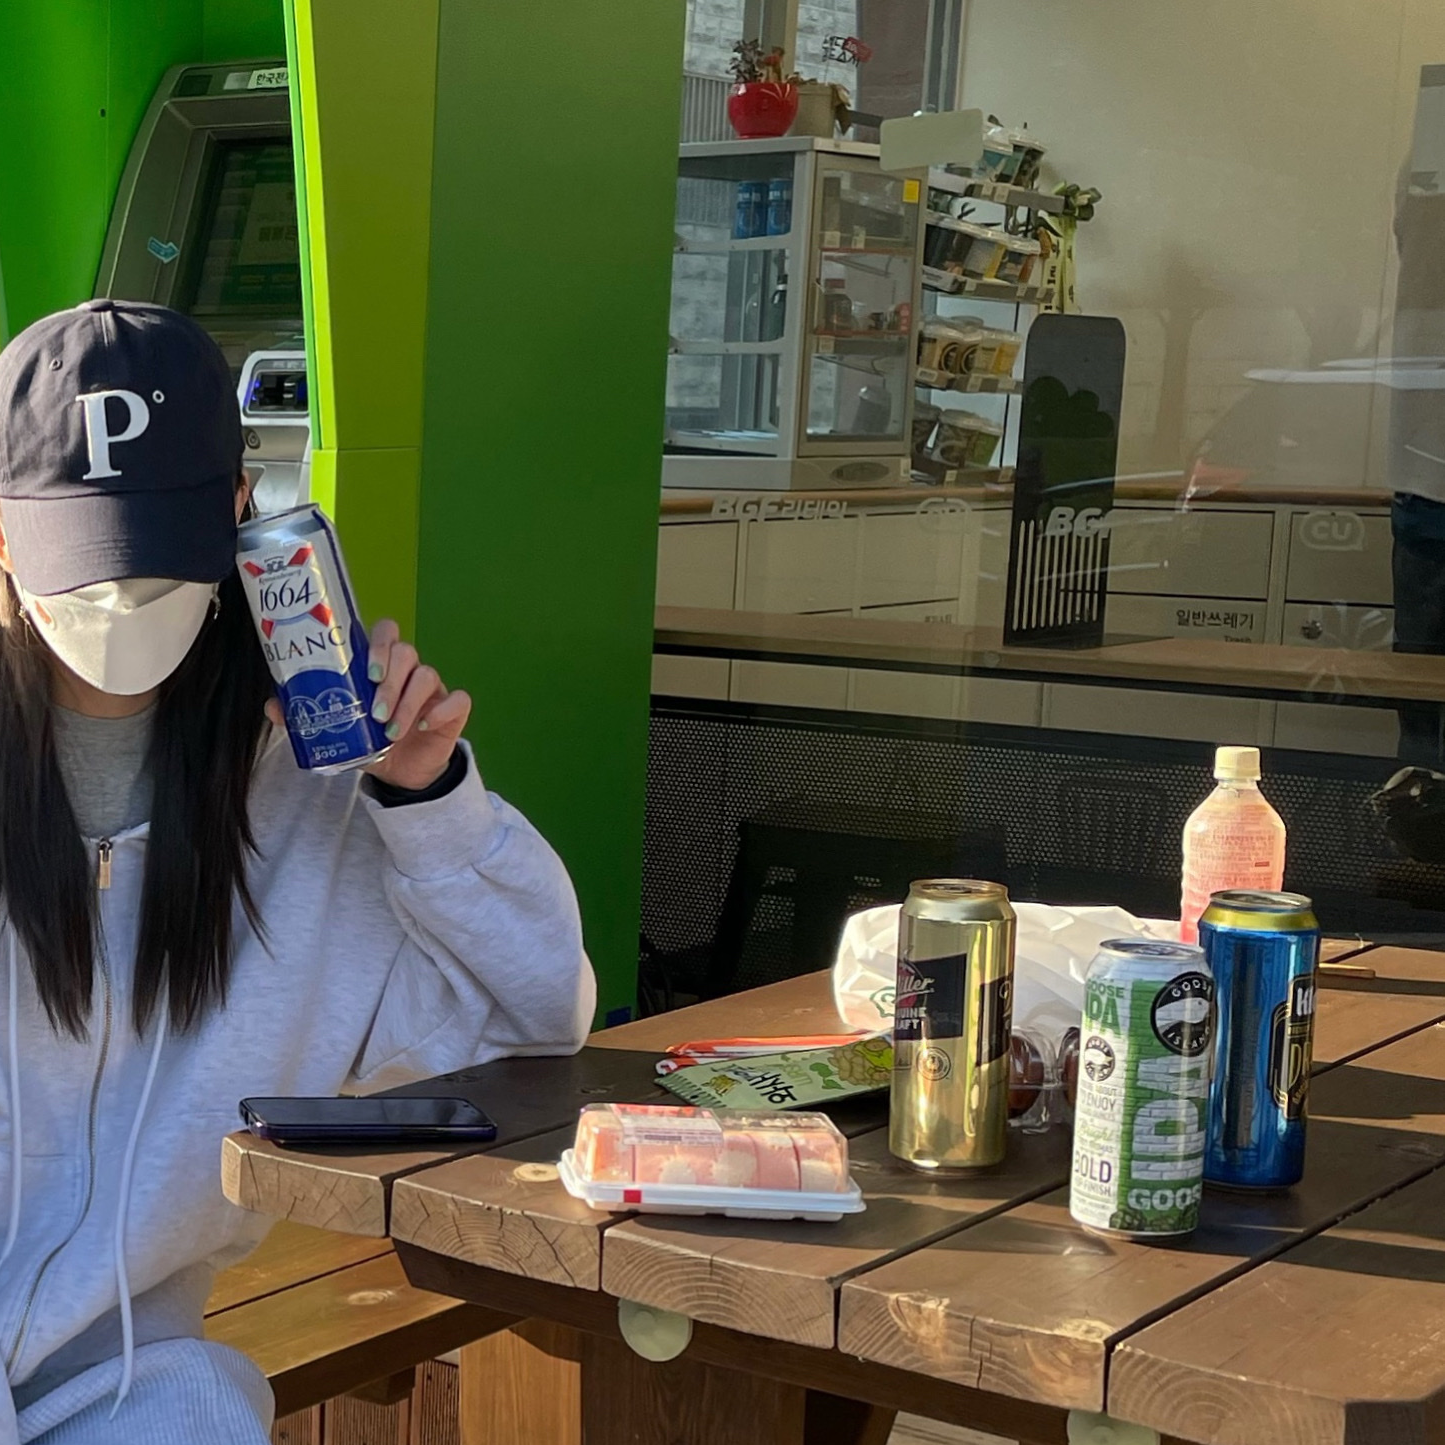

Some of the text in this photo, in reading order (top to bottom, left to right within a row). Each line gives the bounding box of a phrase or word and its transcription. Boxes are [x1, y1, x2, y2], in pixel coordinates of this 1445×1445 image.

[260, 576, 318, 612] 1664
[1176, 610, 1254, 630] 일반쓰레기
[263, 626, 346, 662] BLANC
